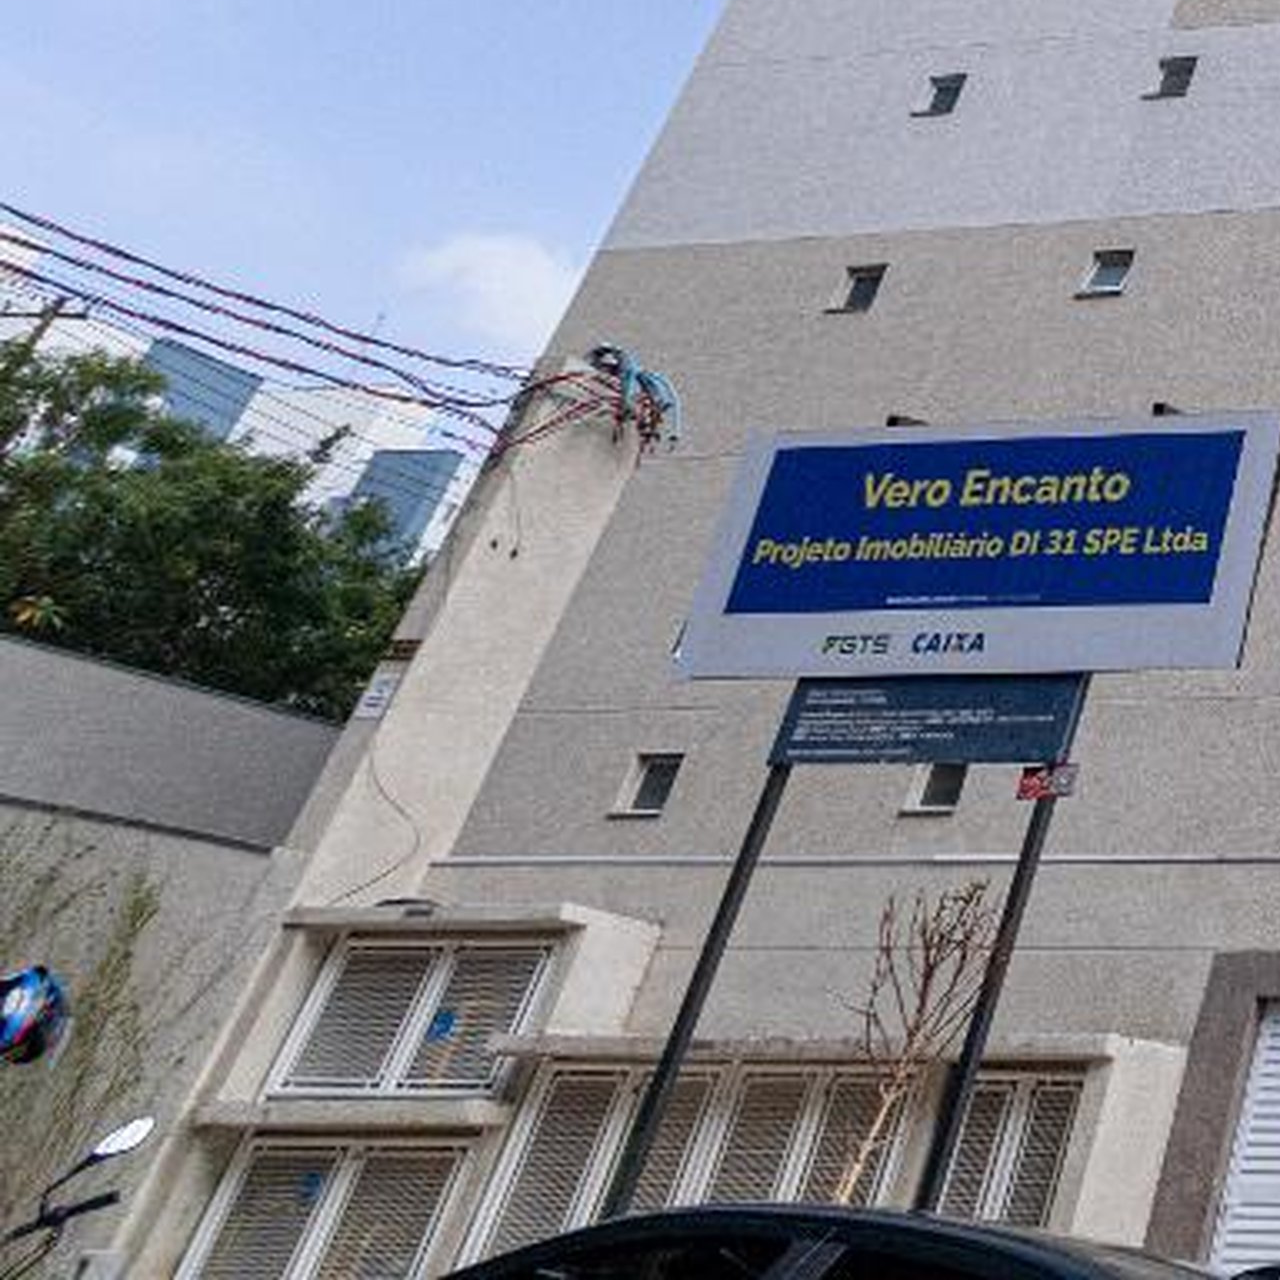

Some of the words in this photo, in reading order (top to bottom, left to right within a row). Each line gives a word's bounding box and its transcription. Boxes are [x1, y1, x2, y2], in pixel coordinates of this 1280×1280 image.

[865, 473, 951, 508] Vero
[960, 467, 1131, 506] Encanto
[752, 537, 851, 568] Projeto
[855, 532, 1004, 561] Imobiliário
[1010, 530, 1040, 556] DI
[1044, 529, 1077, 555] 31
[1083, 528, 1139, 555] SPE
[1143, 526, 1208, 554] Ltda
[822, 634, 891, 655] FGTS
[911, 633, 985, 655] CAIXA
